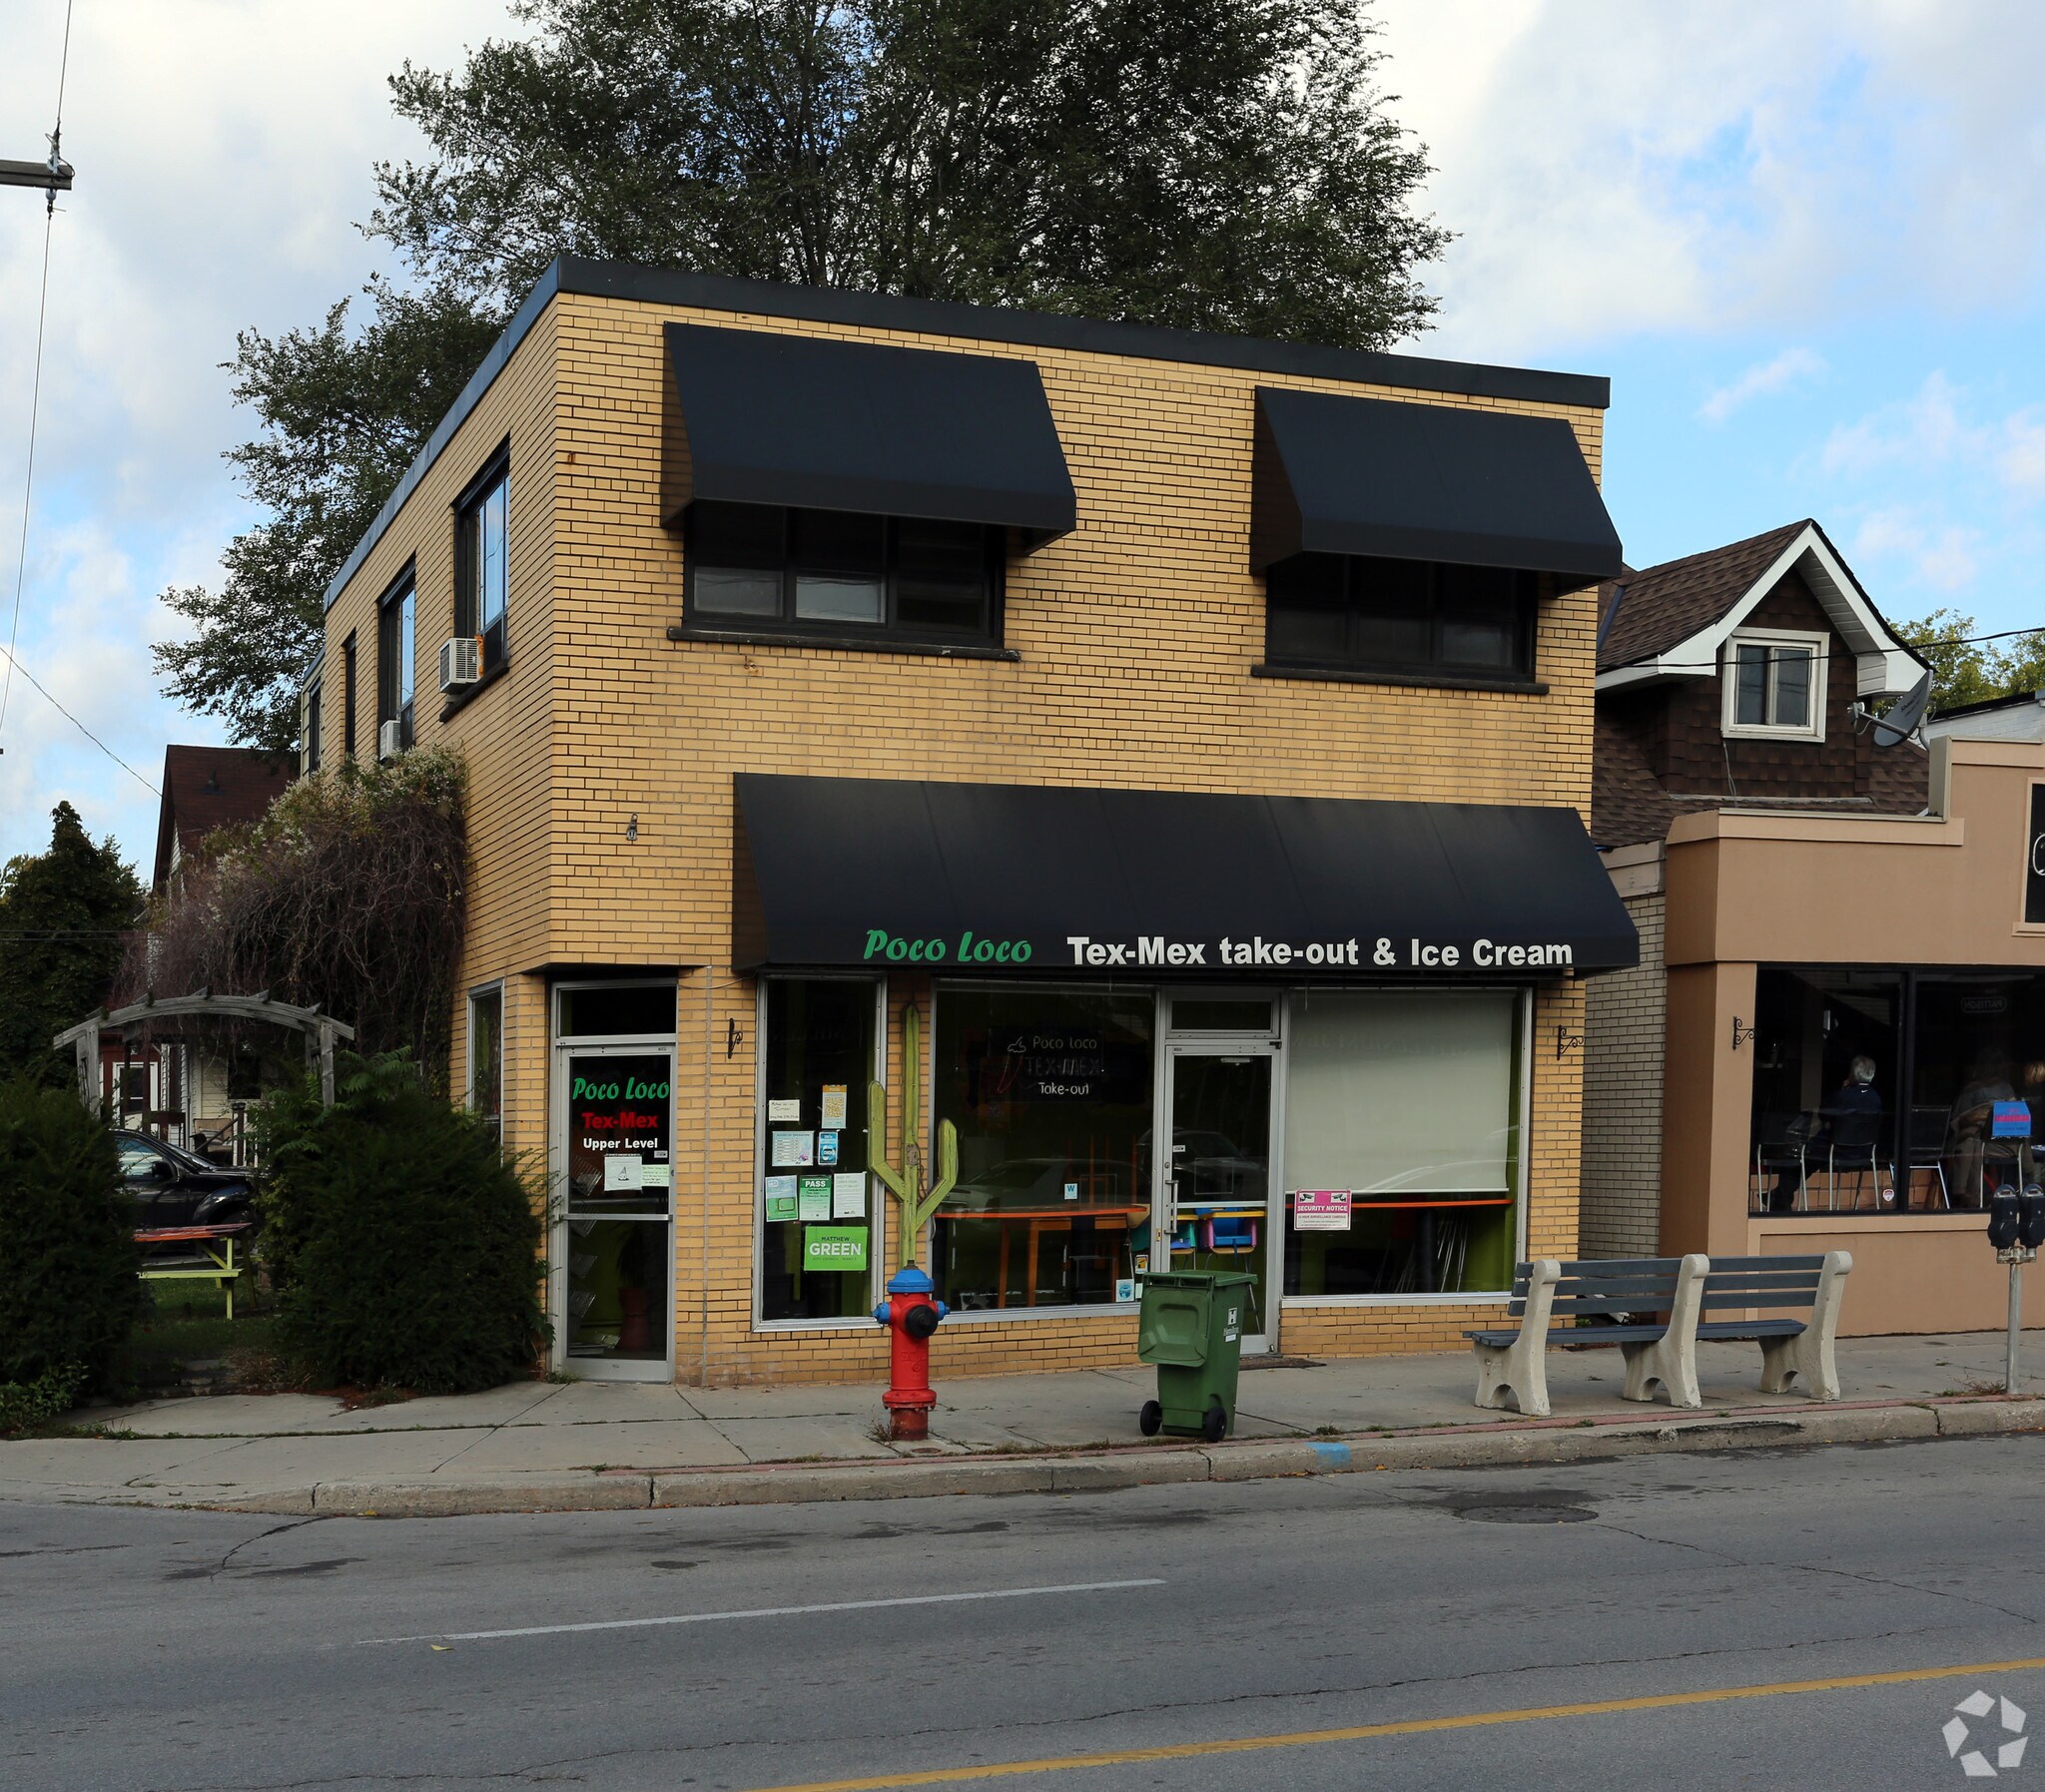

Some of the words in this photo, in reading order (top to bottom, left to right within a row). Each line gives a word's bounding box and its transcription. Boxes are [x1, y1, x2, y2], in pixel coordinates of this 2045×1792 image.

[864, 928, 947, 961] Poco
[957, 930, 1032, 963] Loco
[1066, 935, 1206, 965] Tex-Mex
[1219, 935, 1359, 965] take-out
[1373, 936, 1397, 966] &
[1411, 938, 1460, 966] Ice
[1472, 938, 1574, 966] Cream
[1032, 1035, 1064, 1049] Poco
[572, 1077, 620, 1099] Poco
[625, 1077, 669, 1099] Loco
[1038, 1082, 1089, 1095] Take-out
[581, 1111, 658, 1129] Tex-Mex
[583, 1138, 621, 1151] Upper
[625, 1138, 658, 1149] Level
[809, 1242, 862, 1256] GREEN
